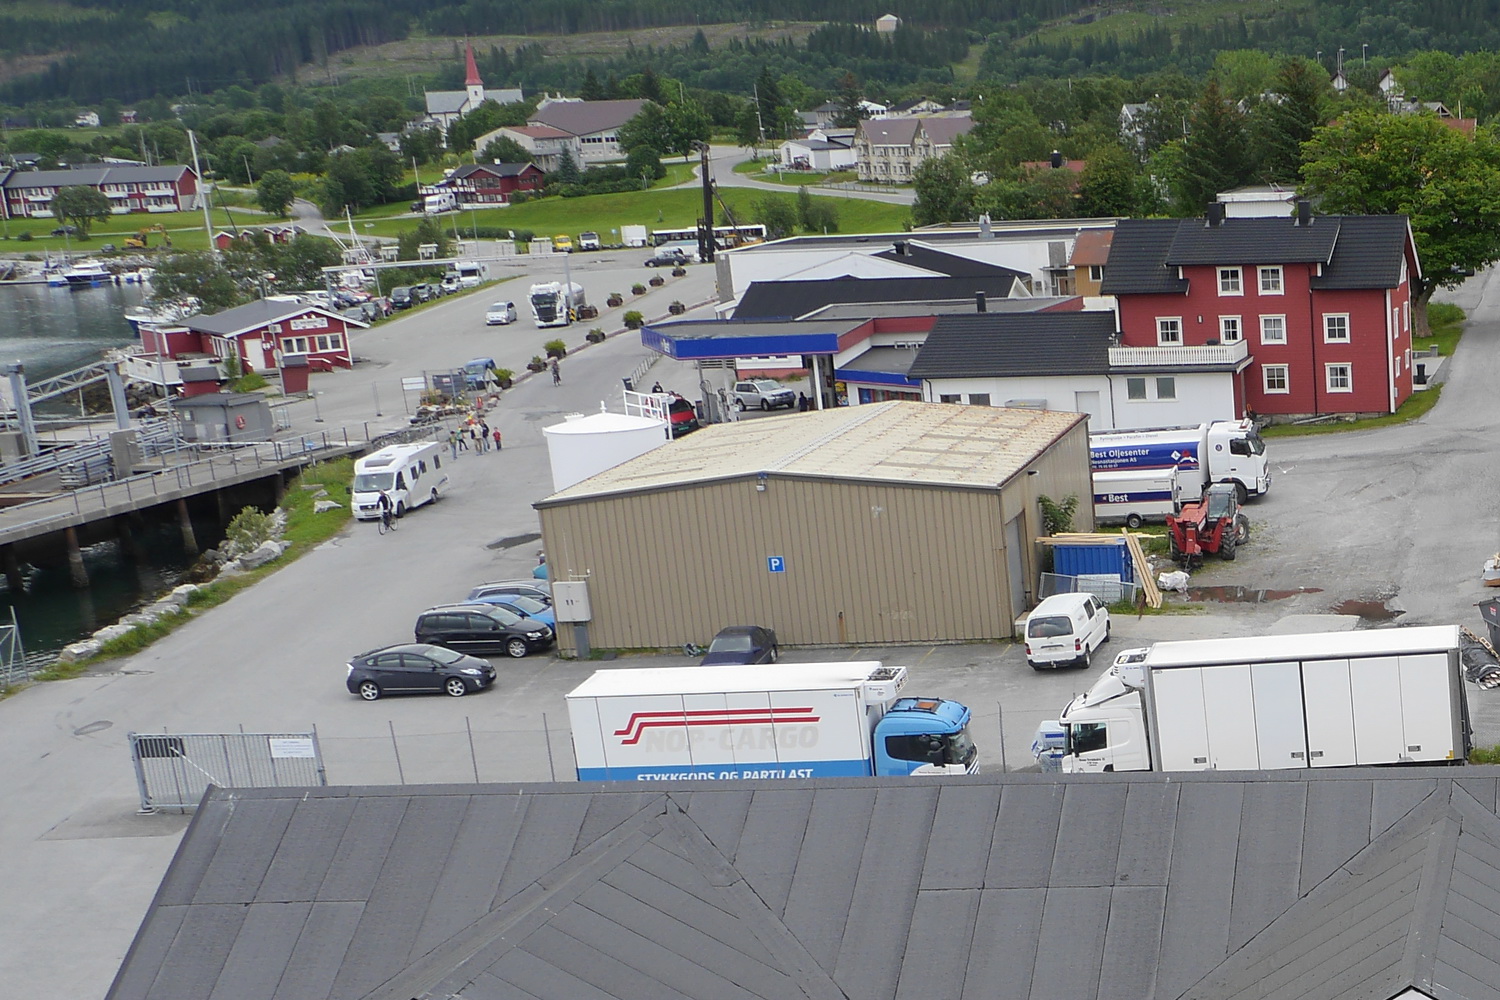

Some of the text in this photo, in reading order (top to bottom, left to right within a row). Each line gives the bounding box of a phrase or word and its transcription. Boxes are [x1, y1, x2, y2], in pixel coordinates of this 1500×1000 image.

[1090, 449, 1150, 459] Best Oljesenter
[1108, 494, 1129, 503] Best
[771, 558, 780, 571] P
